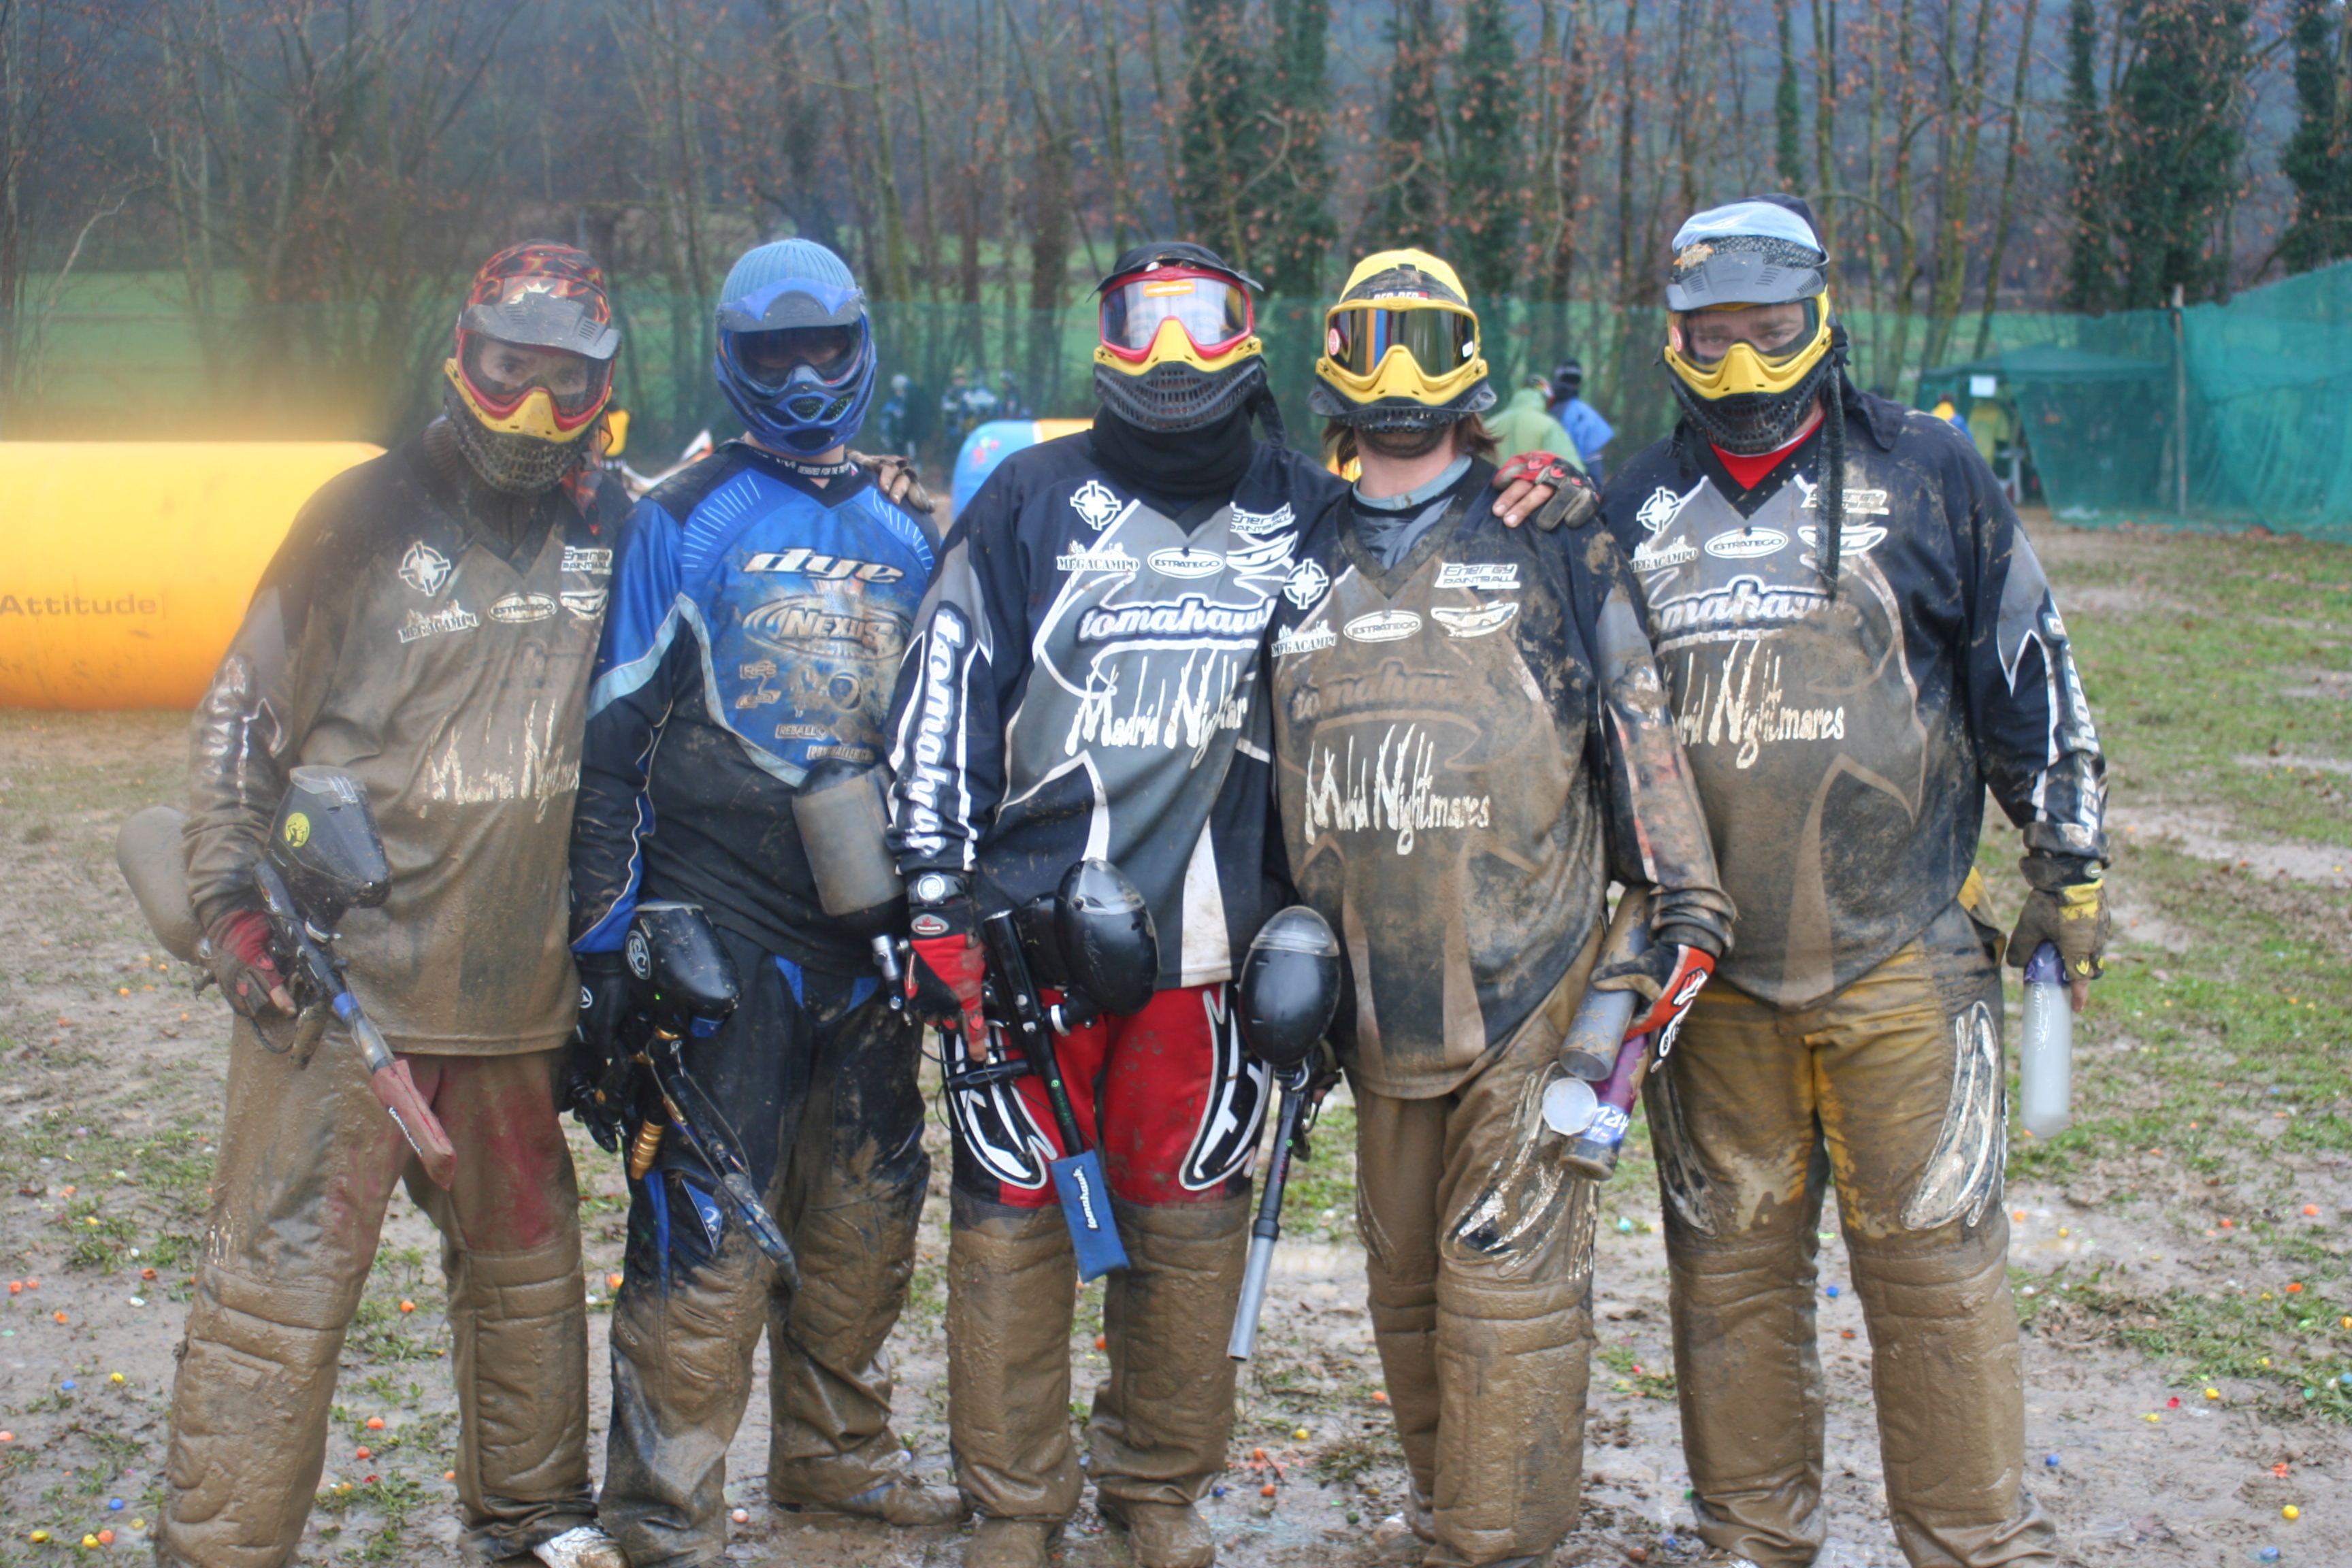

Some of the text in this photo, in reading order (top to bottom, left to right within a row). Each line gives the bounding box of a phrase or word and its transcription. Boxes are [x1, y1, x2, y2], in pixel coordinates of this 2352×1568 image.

[1712, 538, 1783, 551] ESTRATEGO
[744, 547, 905, 583] dye
[1058, 557, 1139, 571] MEGACAMPO
[1154, 558, 1221, 568] ESTRATEGO
[0, 593, 157, 616] Attitude
[779, 606, 895, 648] NEXUS
[1352, 620, 1419, 635] ESTRATEGO
[1064, 656, 1166, 757] Madrid
[779, 725, 817, 736] REBALL
[1373, 723, 1490, 855] Nightmares
[1072, 1165, 1099, 1229] tomahawk
